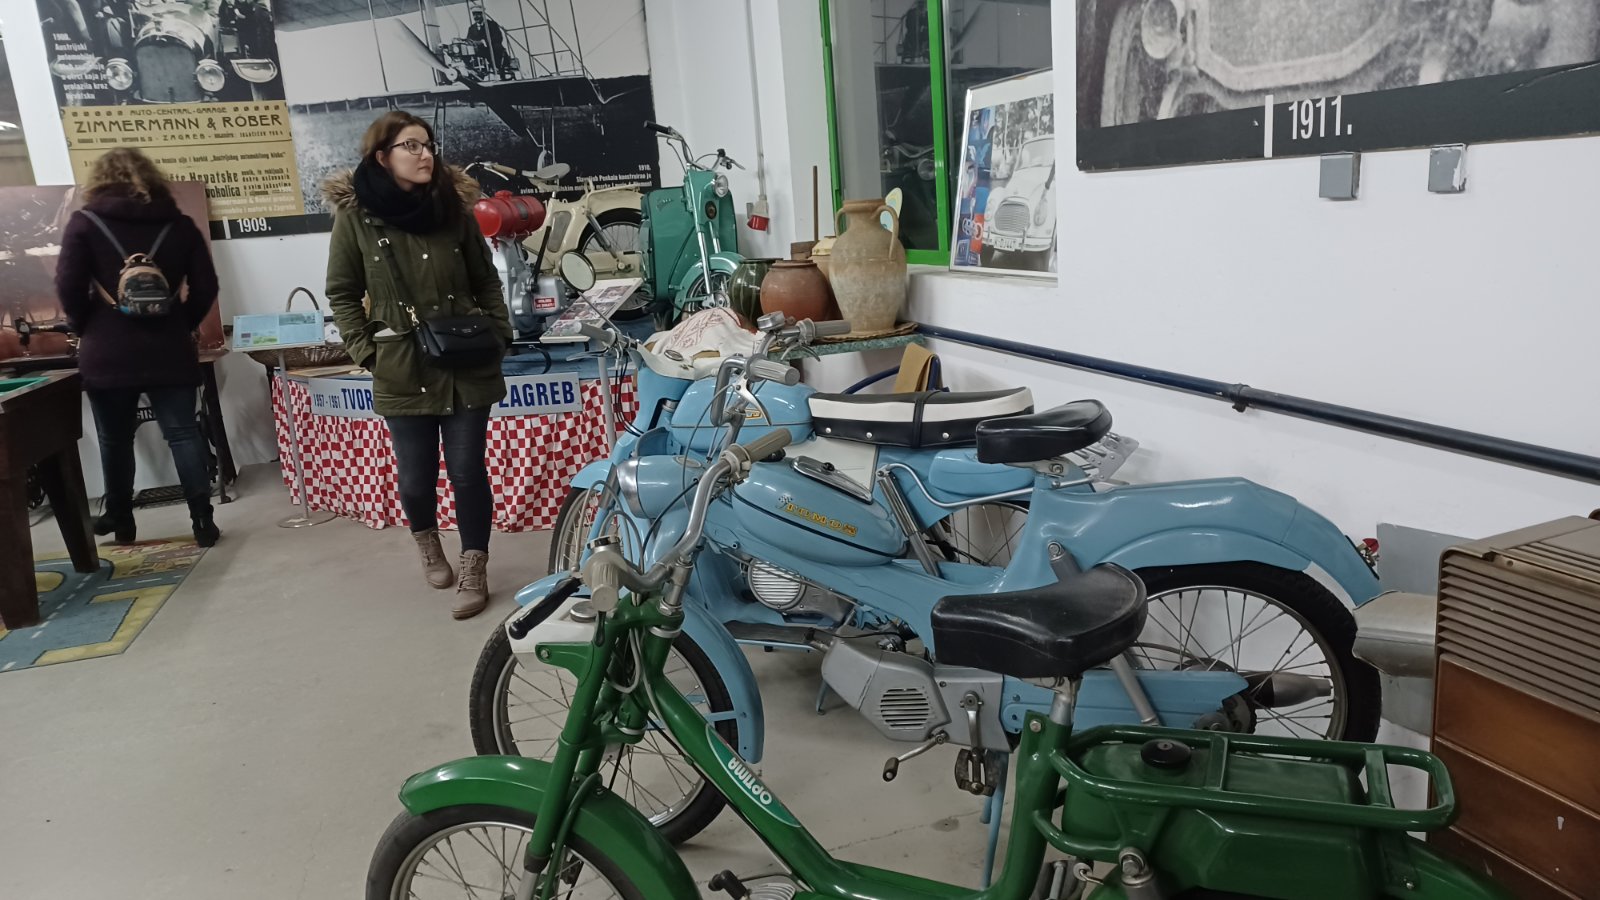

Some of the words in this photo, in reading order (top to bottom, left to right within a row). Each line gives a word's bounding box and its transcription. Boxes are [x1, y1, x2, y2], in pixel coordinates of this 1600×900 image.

[74, 118, 200, 133] ZIMMERMANN
[207, 117, 217, 130] &
[1289, 95, 1352, 140] 1911.
[205, 185, 241, 198] vokolica
[237, 217, 272, 233] 1909.
[341, 388, 374, 411] TVOR
[785, 503, 858, 538] TOMOS
[727, 756, 773, 805] OPTIMA
